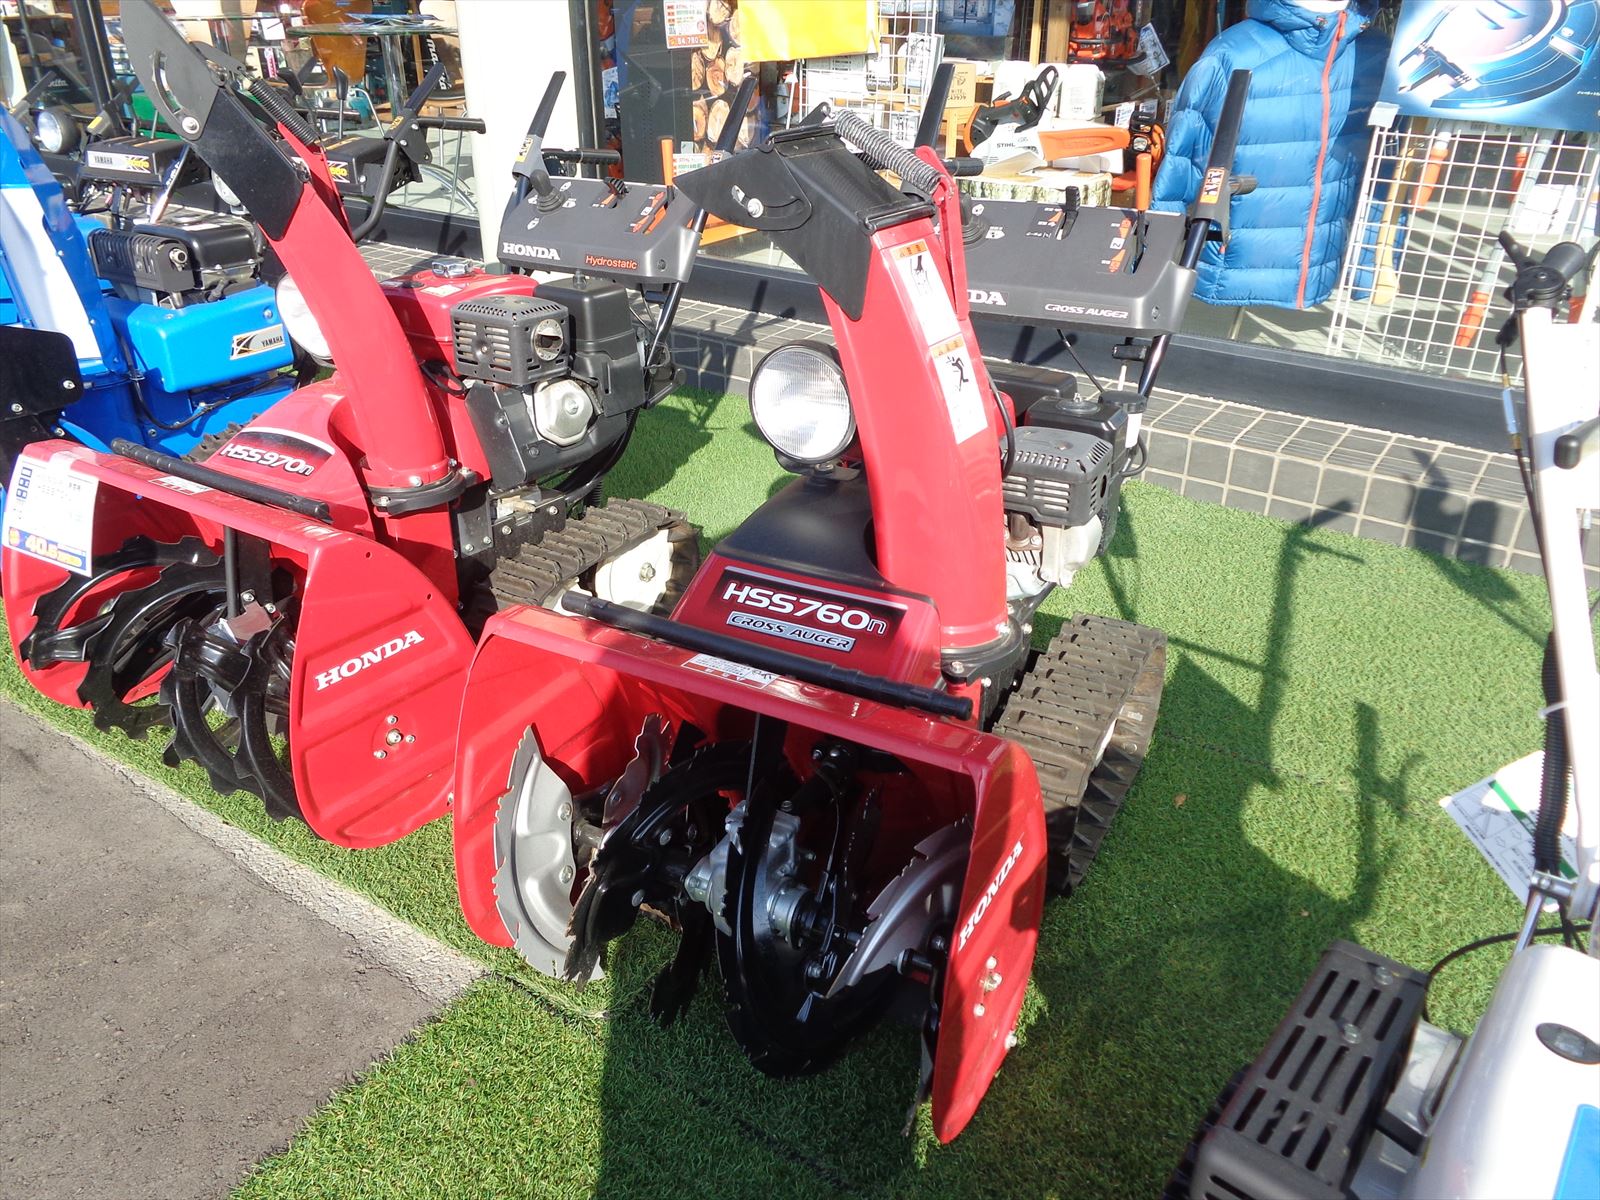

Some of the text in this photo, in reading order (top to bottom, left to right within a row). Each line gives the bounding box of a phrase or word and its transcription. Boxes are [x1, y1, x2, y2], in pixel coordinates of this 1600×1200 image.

[502, 242, 561, 260] HONDA
[585, 254, 639, 270] Hydrostatic
[1045, 303, 1128, 319] CROSS AUGER
[261, 335, 283, 348] YAMAHA
[220, 443, 315, 476] HSS970n
[722, 582, 888, 635] HSS760n
[731, 615, 850, 650] CROSS AUGER
[315, 630, 425, 691] HONDA
[959, 841, 1024, 952] HONDA
